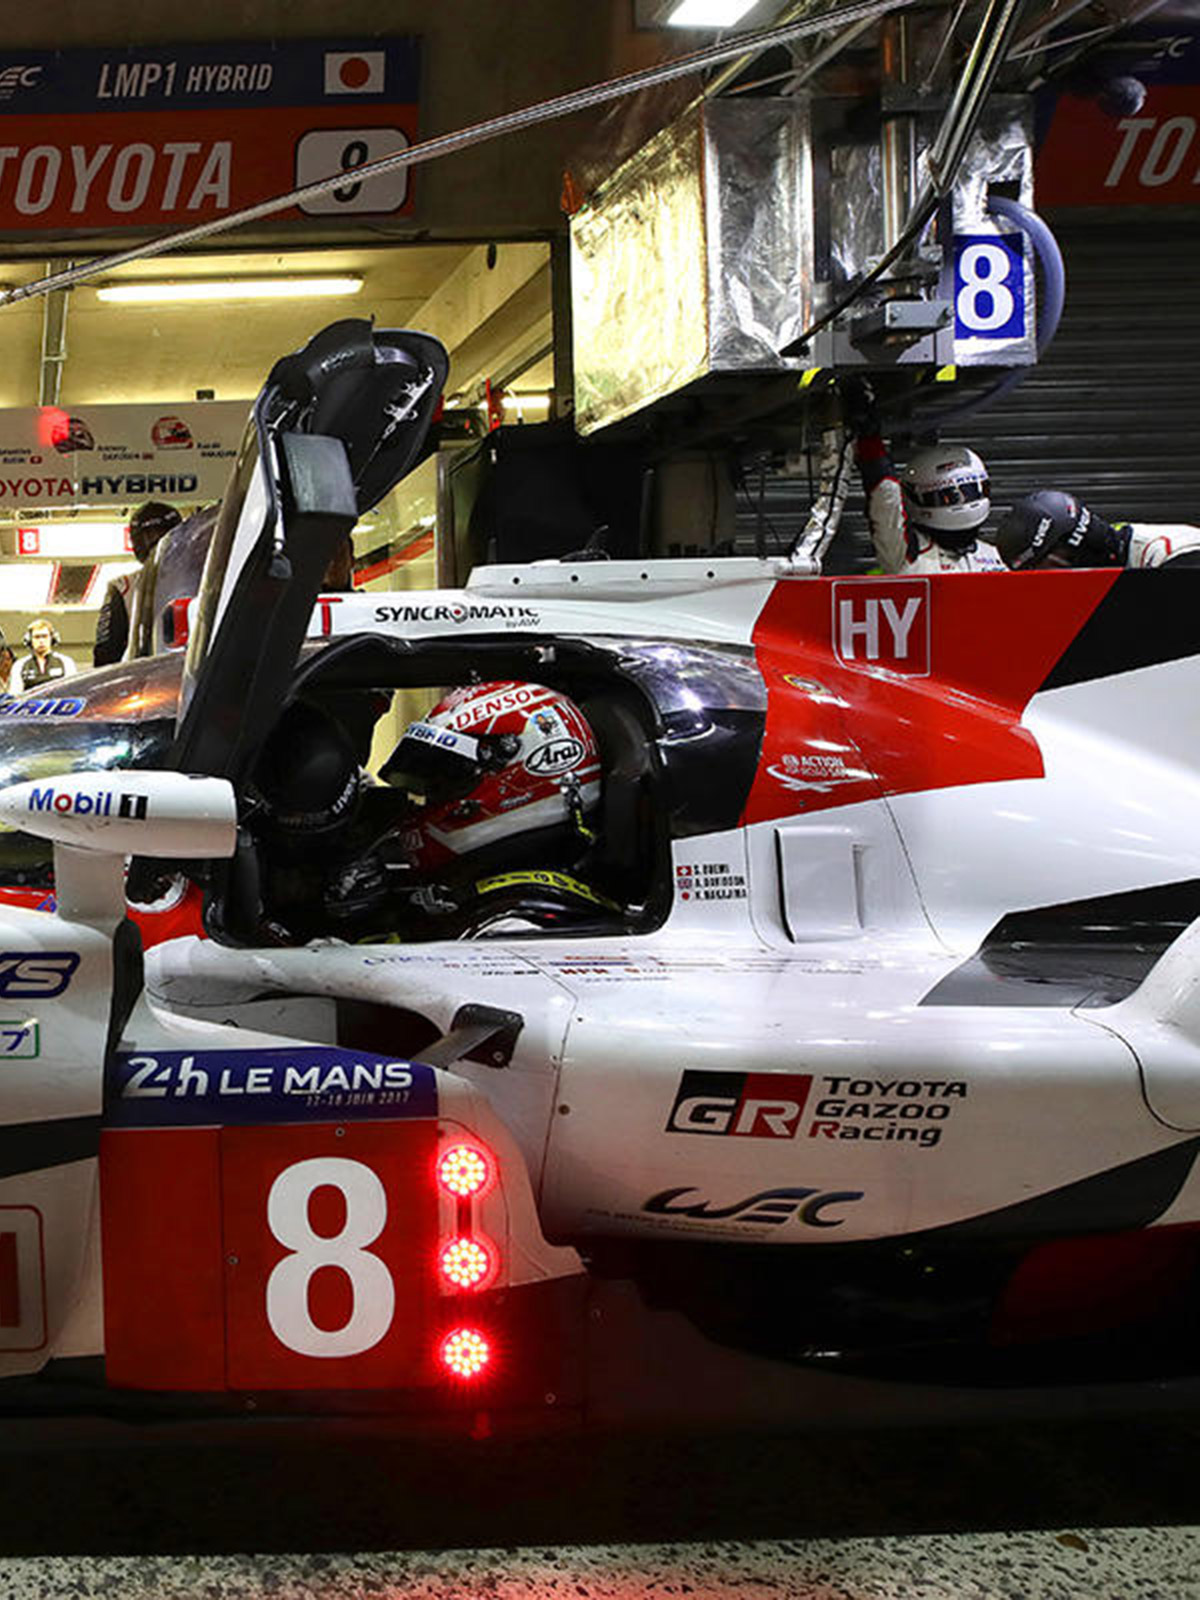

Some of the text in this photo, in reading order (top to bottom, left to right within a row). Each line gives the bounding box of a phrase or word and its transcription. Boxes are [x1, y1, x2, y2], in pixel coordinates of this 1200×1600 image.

[97, 62, 273, 98] LMP1 HYBRID
[1104, 116, 1200, 187] TO
[957, 243, 1014, 331] 8
[81, 474, 198, 495] HYBRID
[840, 597, 922, 660] HY
[455, 689, 532, 730] DENSO
[528, 743, 579, 770] Arai
[28, 788, 113, 817] Mobil
[122, 1056, 414, 1098] 24h LE MANS
[823, 1076, 968, 1099] TOYOTA
[673, 1096, 800, 1137] GR
[815, 1099, 950, 1120] GAZOO
[808, 1121, 943, 1148] Racing
[640, 1187, 865, 1228] WEC
[266, 1157, 395, 1358] 8
